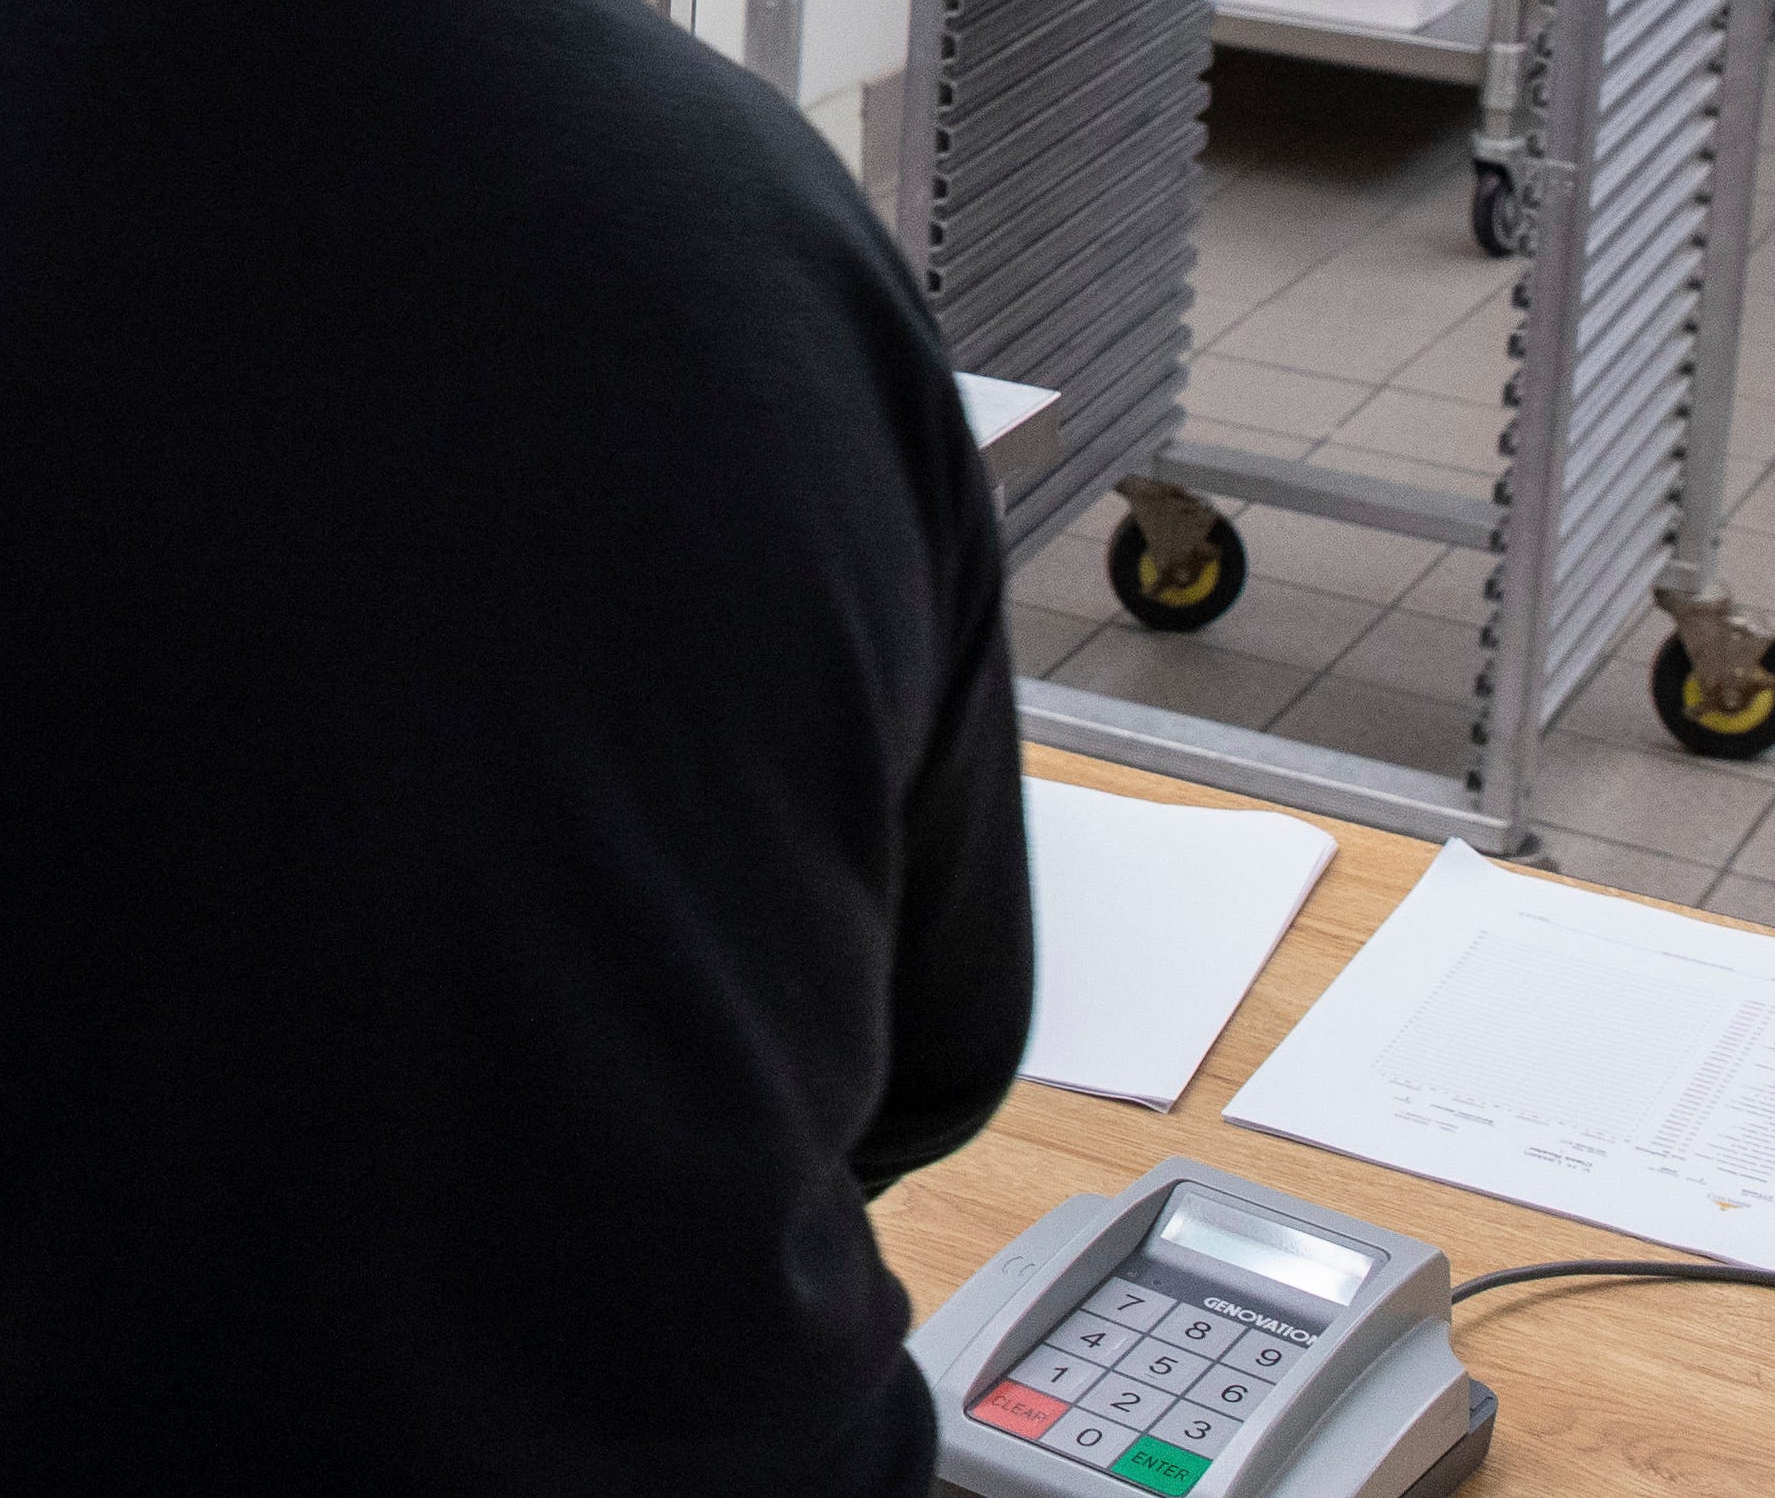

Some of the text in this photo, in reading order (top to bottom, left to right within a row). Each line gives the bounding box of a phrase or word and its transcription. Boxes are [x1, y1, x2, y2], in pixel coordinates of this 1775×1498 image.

[1117, 1294, 1283, 1367] 7 8 9
[1203, 1297, 1319, 1346] GENOVATION
[1080, 1332, 1249, 1403] 4 5 6
[991, 1395, 1049, 1423] CLEAR
[1050, 1367, 1212, 1440] 1 2 3
[1076, 1428, 1103, 1447] 0
[1130, 1451, 1191, 1482] ENTER
